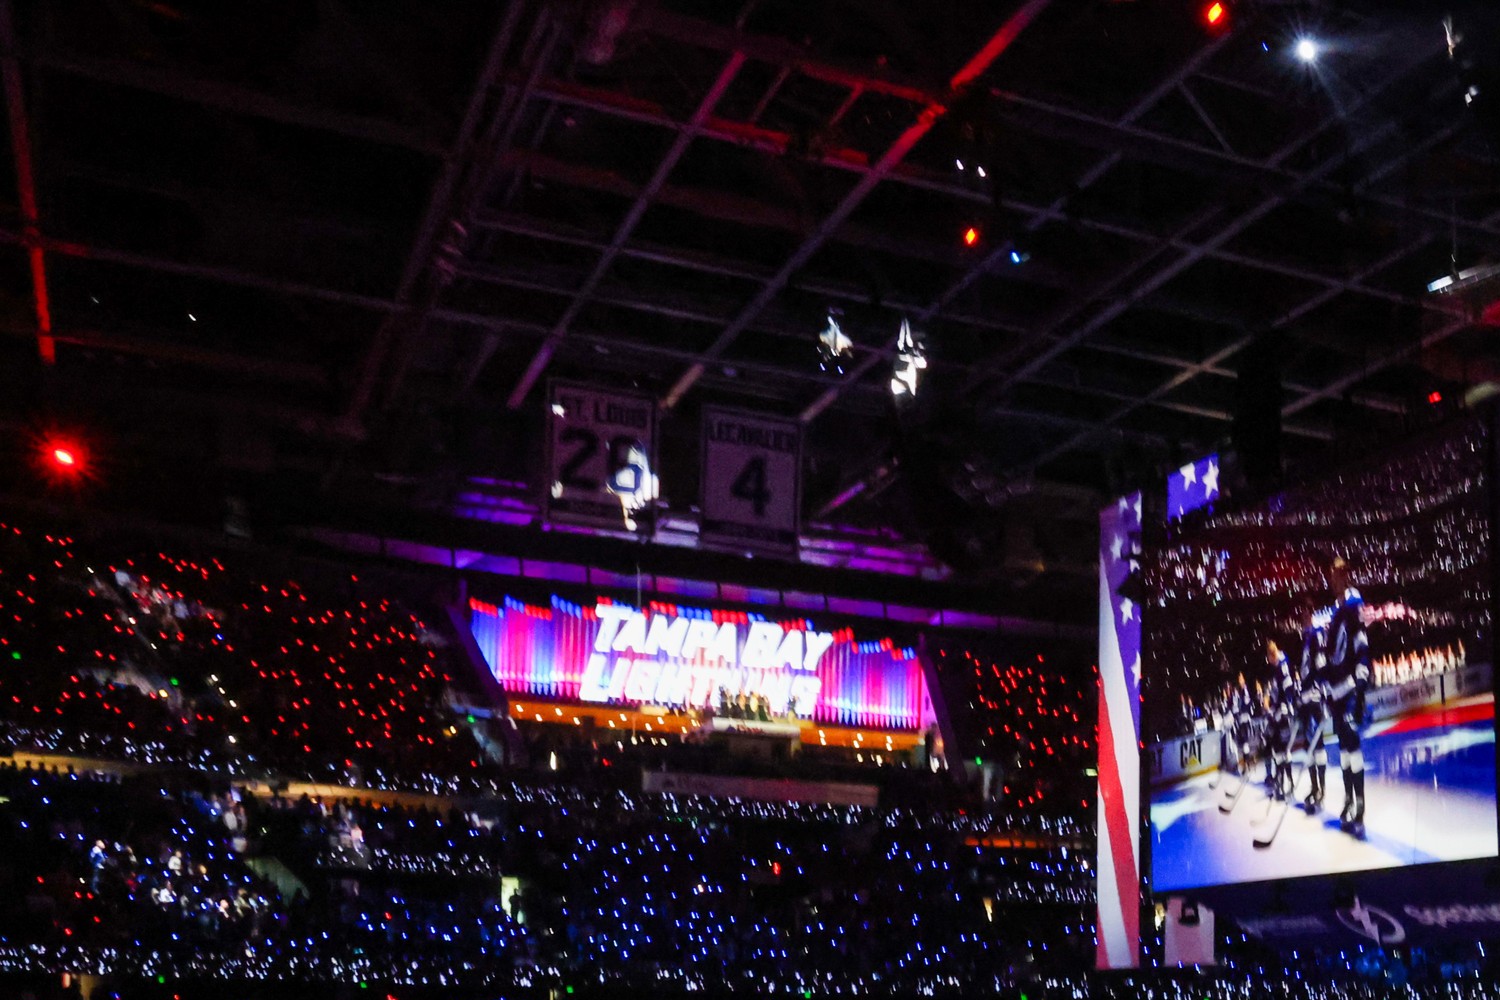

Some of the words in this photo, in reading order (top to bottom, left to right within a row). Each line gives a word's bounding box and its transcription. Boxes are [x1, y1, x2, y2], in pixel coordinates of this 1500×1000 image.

[731, 454, 771, 517] 4
[595, 603, 738, 664] TAMPA
[741, 620, 834, 671] BAY
[1180, 738, 1203, 769] CAT
